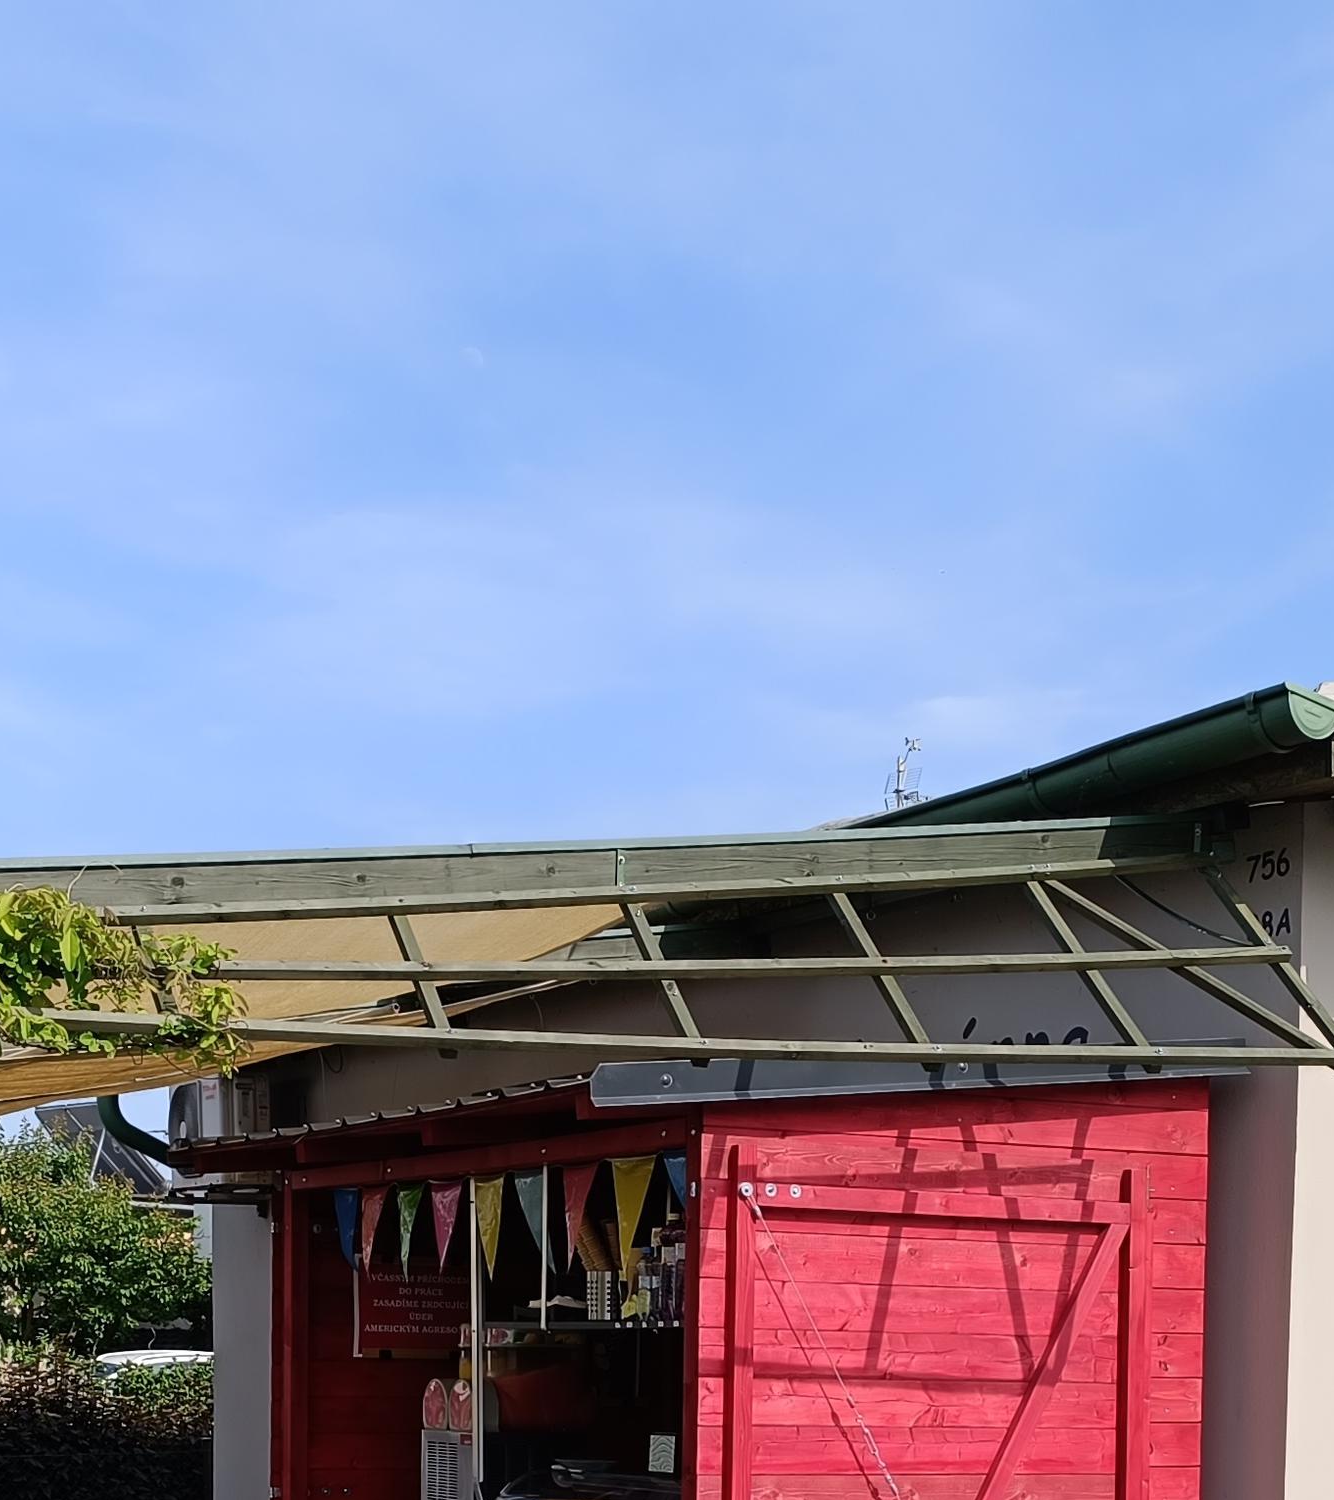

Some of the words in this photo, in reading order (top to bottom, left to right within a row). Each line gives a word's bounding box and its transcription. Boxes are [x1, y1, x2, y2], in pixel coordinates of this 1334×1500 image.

[1246, 847, 1290, 883] 756
[1255, 907, 1291, 936] 8A
[399, 1287, 411, 1295] DO
[415, 1287, 444, 1296] PRÁCE
[373, 1299, 419, 1308] ZASADÍME
[364, 1323, 419, 1334] AMERICKÝM
